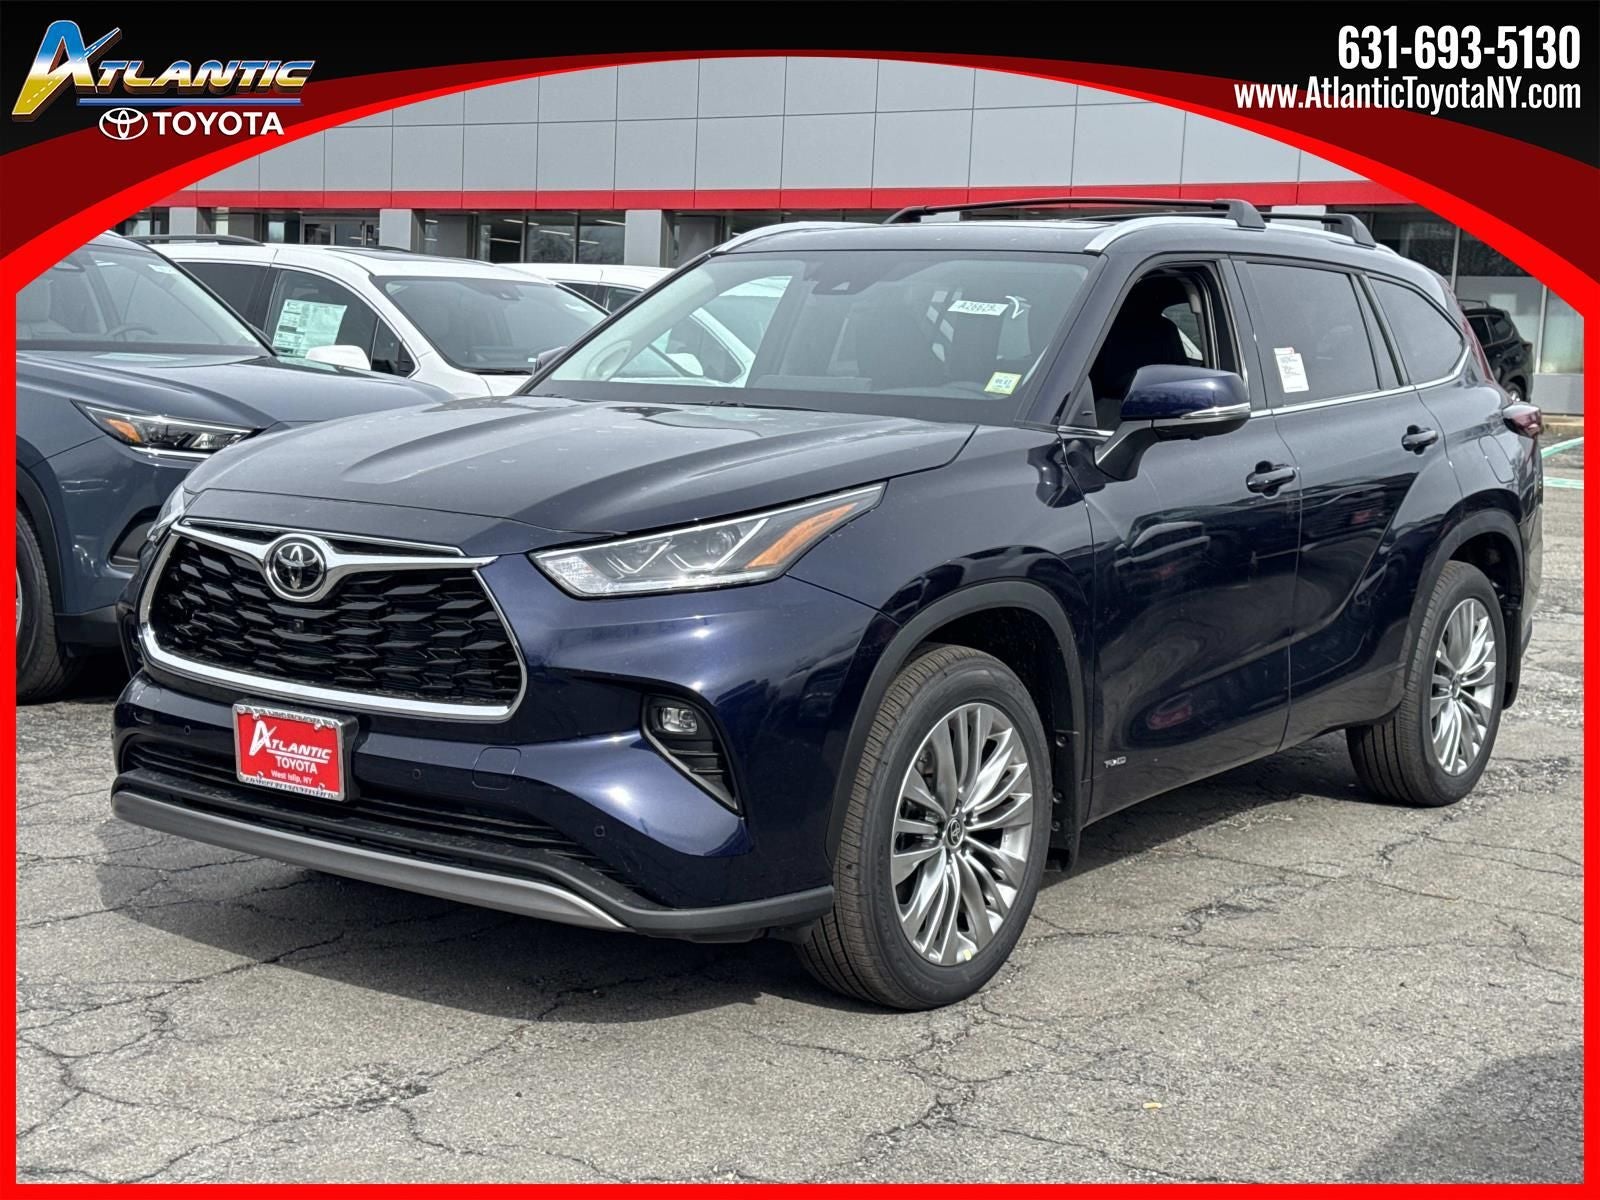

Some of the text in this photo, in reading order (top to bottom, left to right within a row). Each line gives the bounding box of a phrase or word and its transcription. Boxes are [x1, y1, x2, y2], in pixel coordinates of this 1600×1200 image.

[248, 719, 332, 760] ATLANTIC
[274, 755, 318, 775] TOYOTA
[270, 768, 287, 780] West
[302, 775, 313, 785] NY
